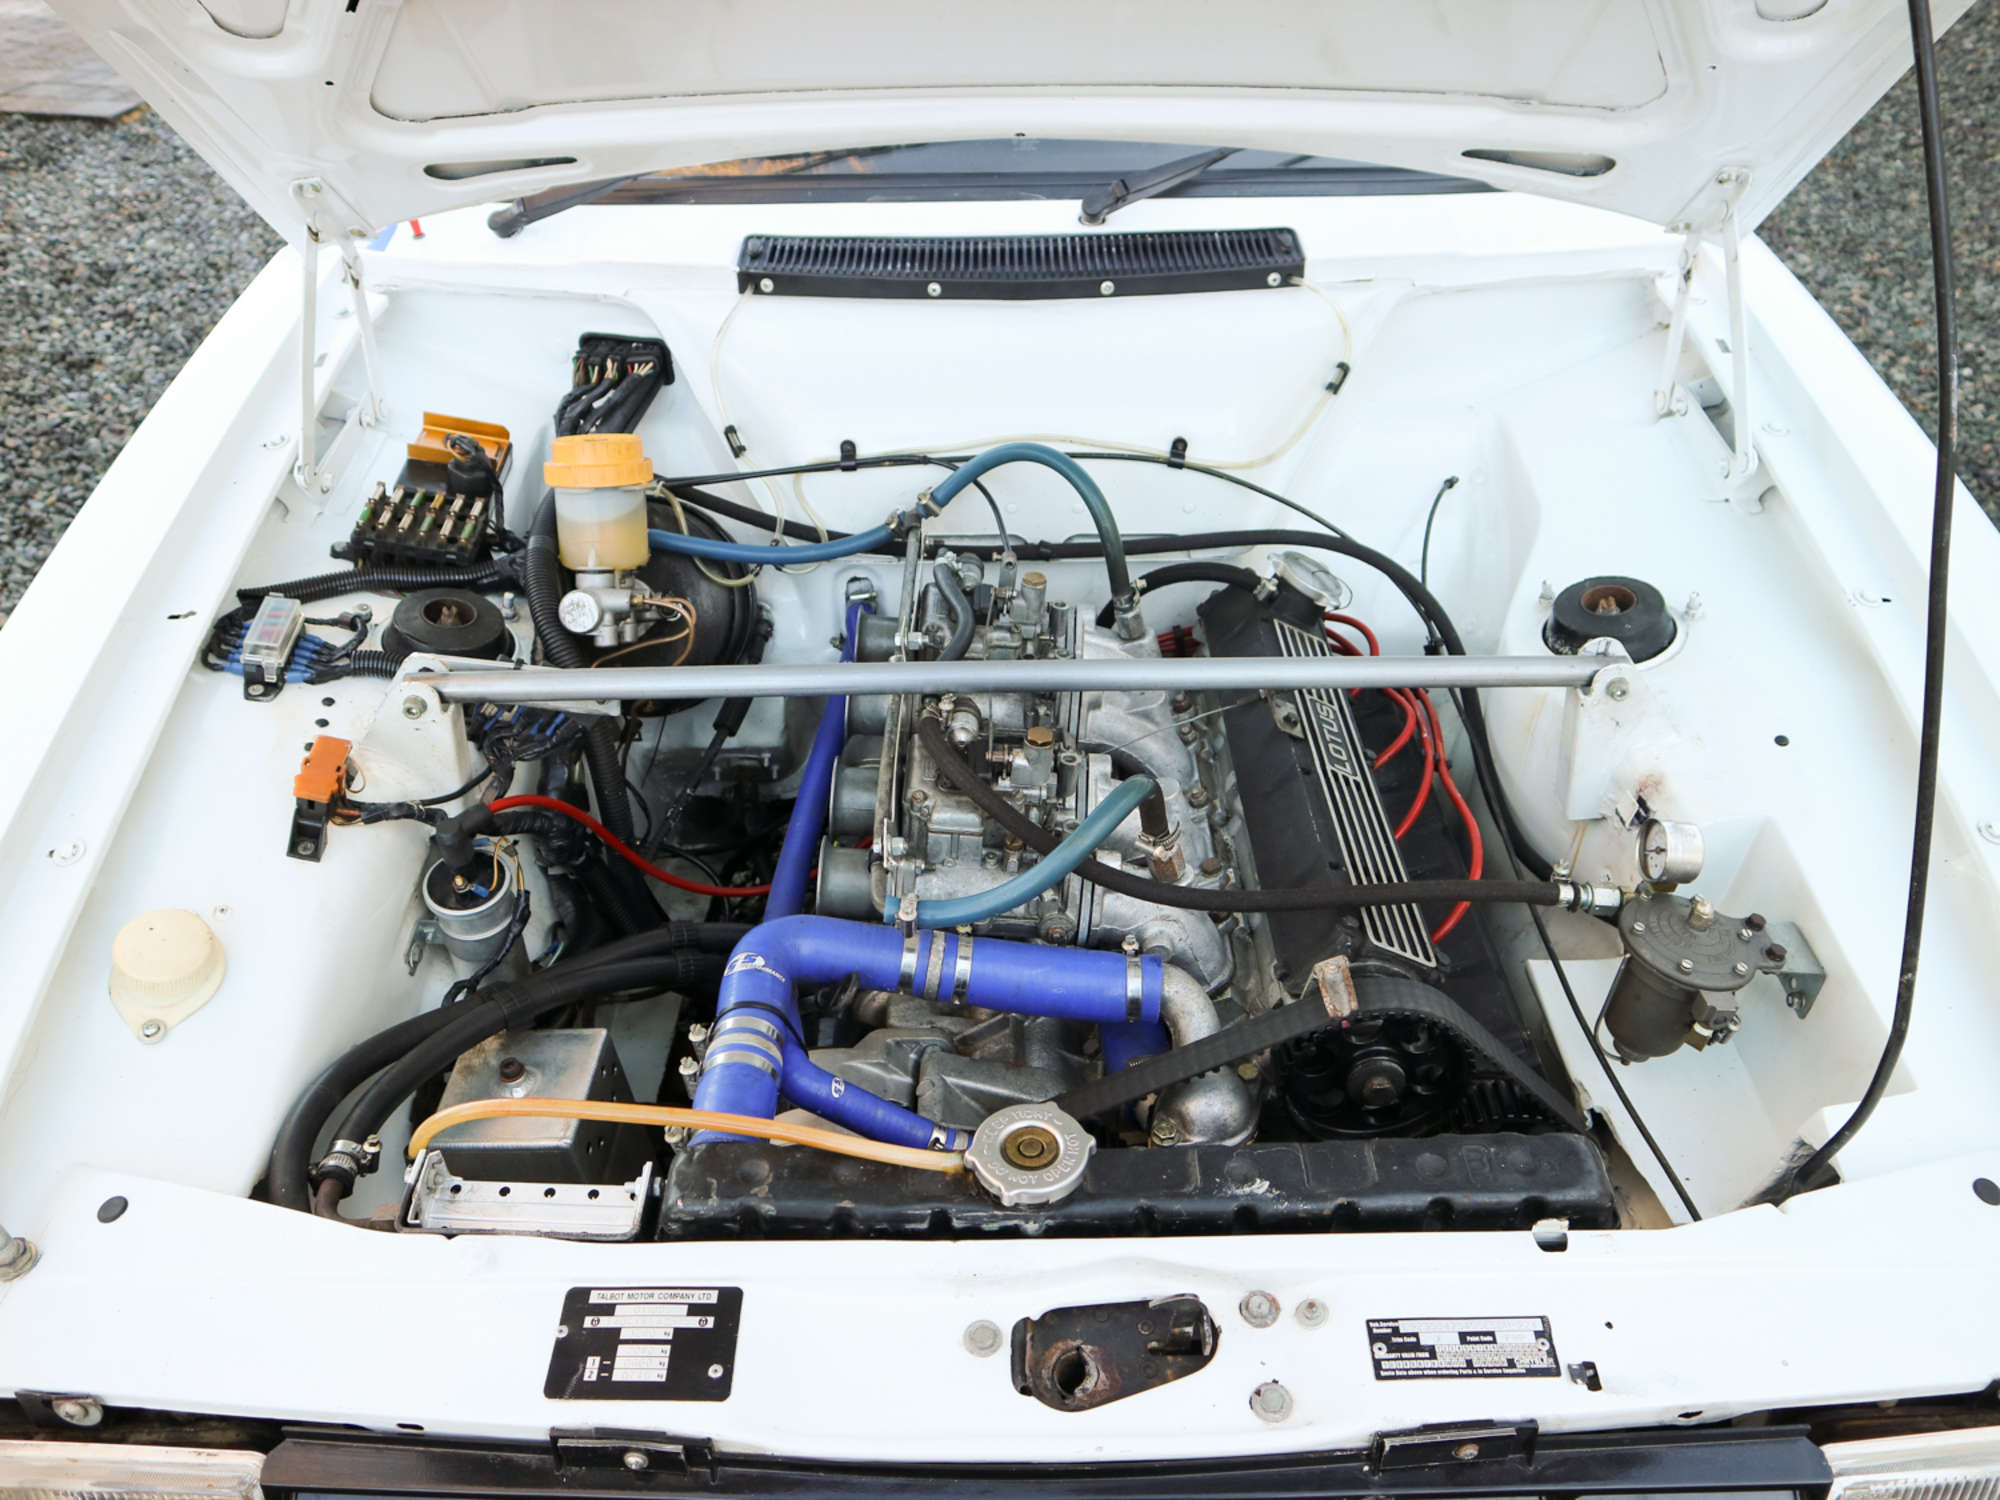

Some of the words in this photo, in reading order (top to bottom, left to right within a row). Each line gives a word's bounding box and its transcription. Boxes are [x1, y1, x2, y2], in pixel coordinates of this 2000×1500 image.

[1317, 703, 1352, 776] LOTUS
[596, 1291, 625, 1301] TALBOT
[627, 1291, 655, 1301] MOTOR
[657, 1291, 696, 1301] COMPANY
[698, 1292, 712, 1301] LTD
[587, 1370, 594, 1379] 2
